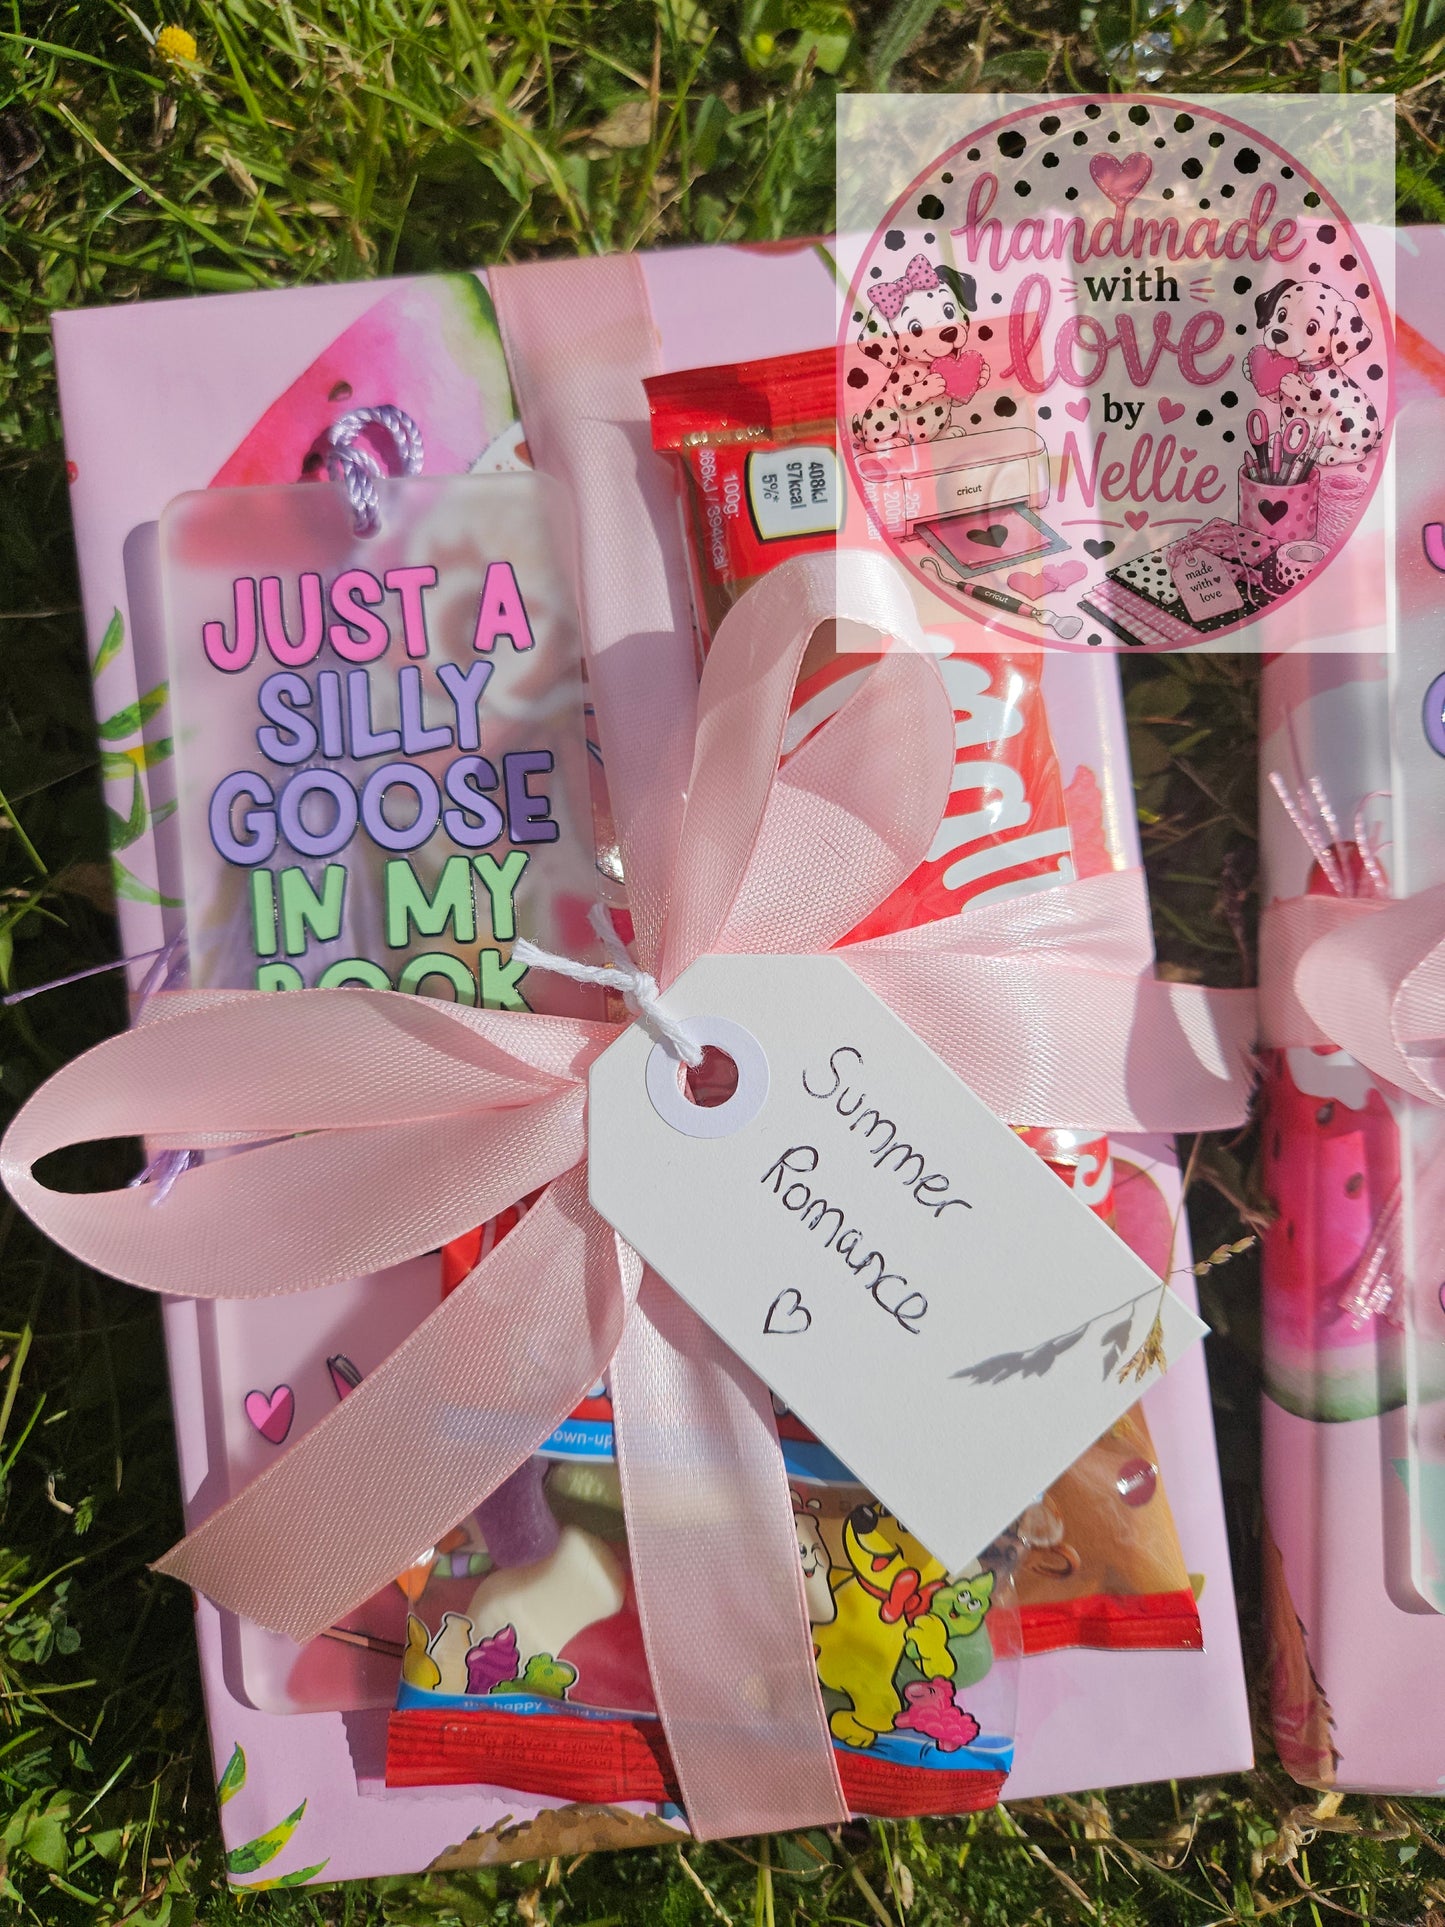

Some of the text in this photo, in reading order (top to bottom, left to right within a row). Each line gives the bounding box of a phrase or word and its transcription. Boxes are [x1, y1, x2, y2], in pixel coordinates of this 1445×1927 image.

[786, 462, 807, 509] 97kcal
[808, 461, 828, 504] 408kJ
[884, 490, 904, 533] 200ml
[202, 561, 535, 674] JUST A
[255, 660, 495, 767] SILLY
[208, 749, 560, 867] GOOSE
[250, 849, 531, 957] IN MY
[802, 1046, 973, 1218] Summer
[761, 1145, 928, 1335] Romance
[550, 1430, 613, 1449] own-up
[494, 1701, 542, 1712] happy
